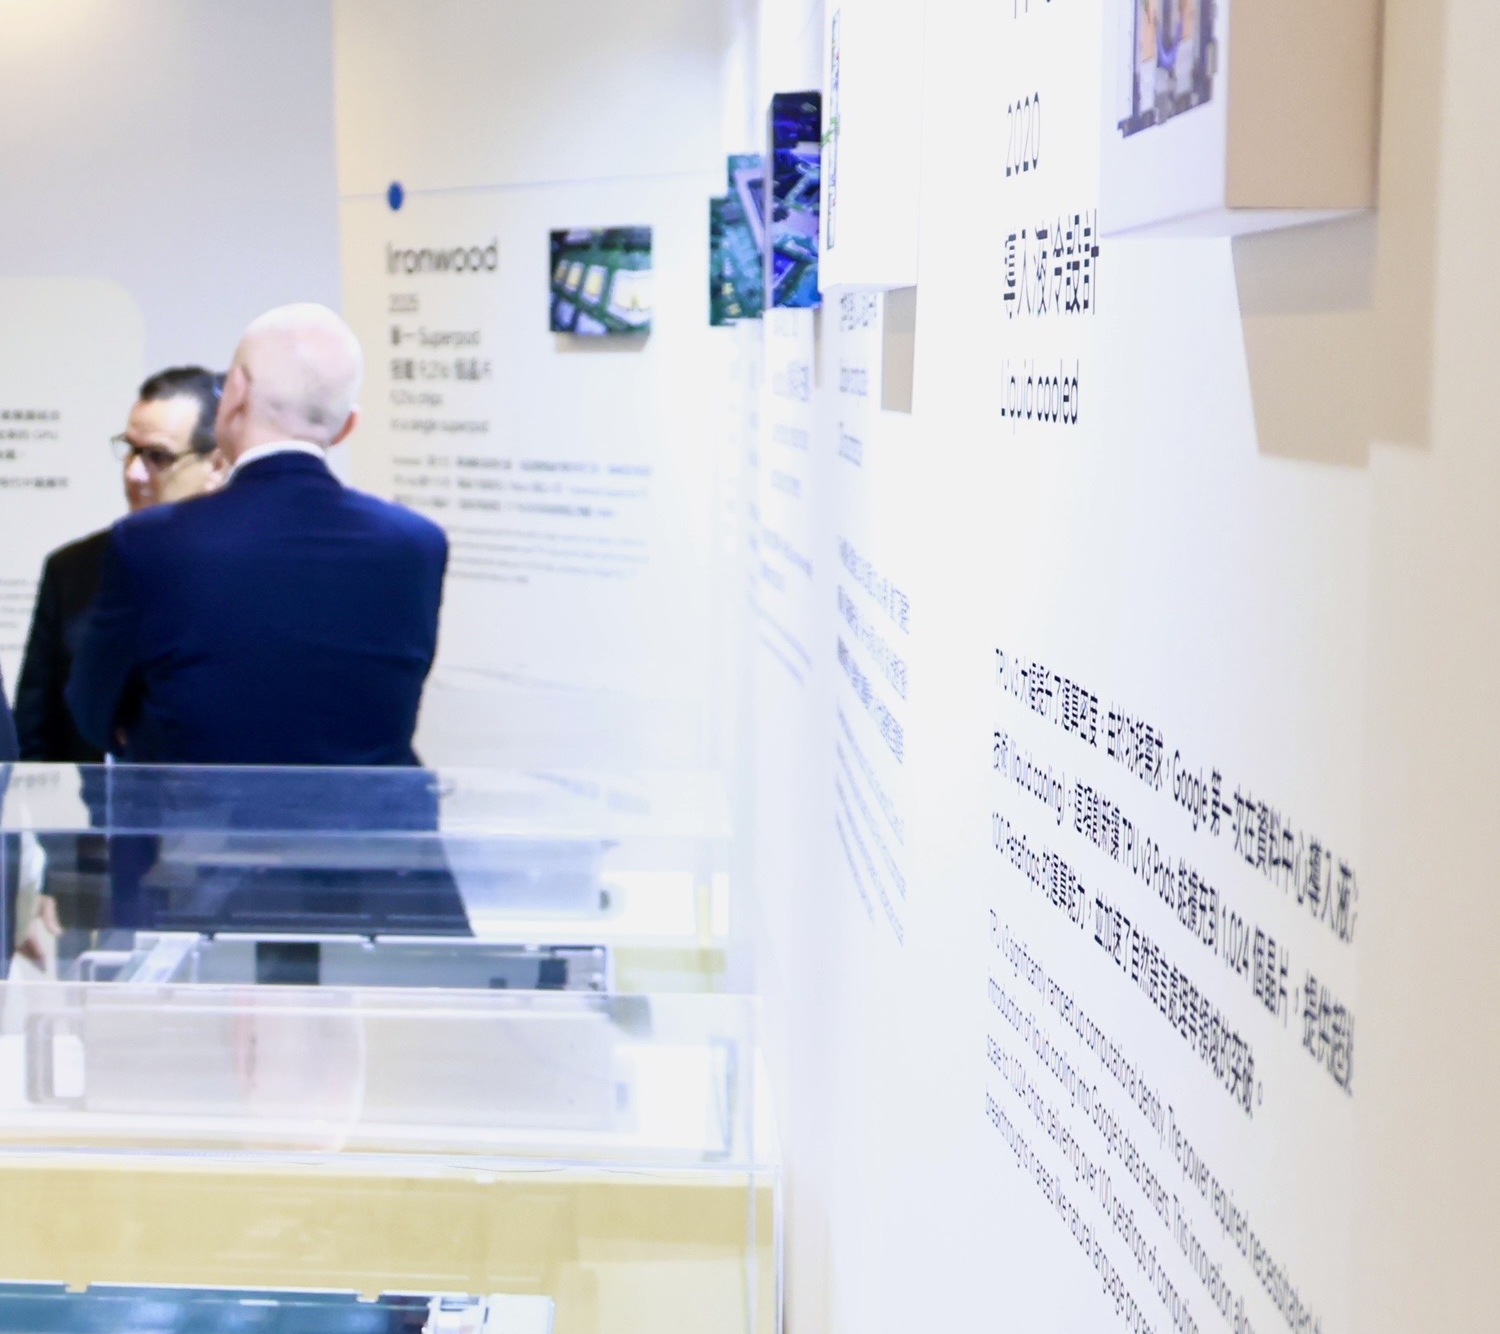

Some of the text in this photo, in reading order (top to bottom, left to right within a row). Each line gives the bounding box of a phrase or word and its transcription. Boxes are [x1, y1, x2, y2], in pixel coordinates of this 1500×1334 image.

[1006, 89, 1041, 174] 2020
[386, 238, 498, 275] Ironwood
[1003, 207, 1100, 319] 導入液冷設計
[1036, 358, 1081, 424] cooled
[1172, 749, 1208, 831] Google
[1122, 814, 1139, 874] TPU
[1152, 840, 1176, 908] Pods
[1222, 903, 1249, 980] 1,024
